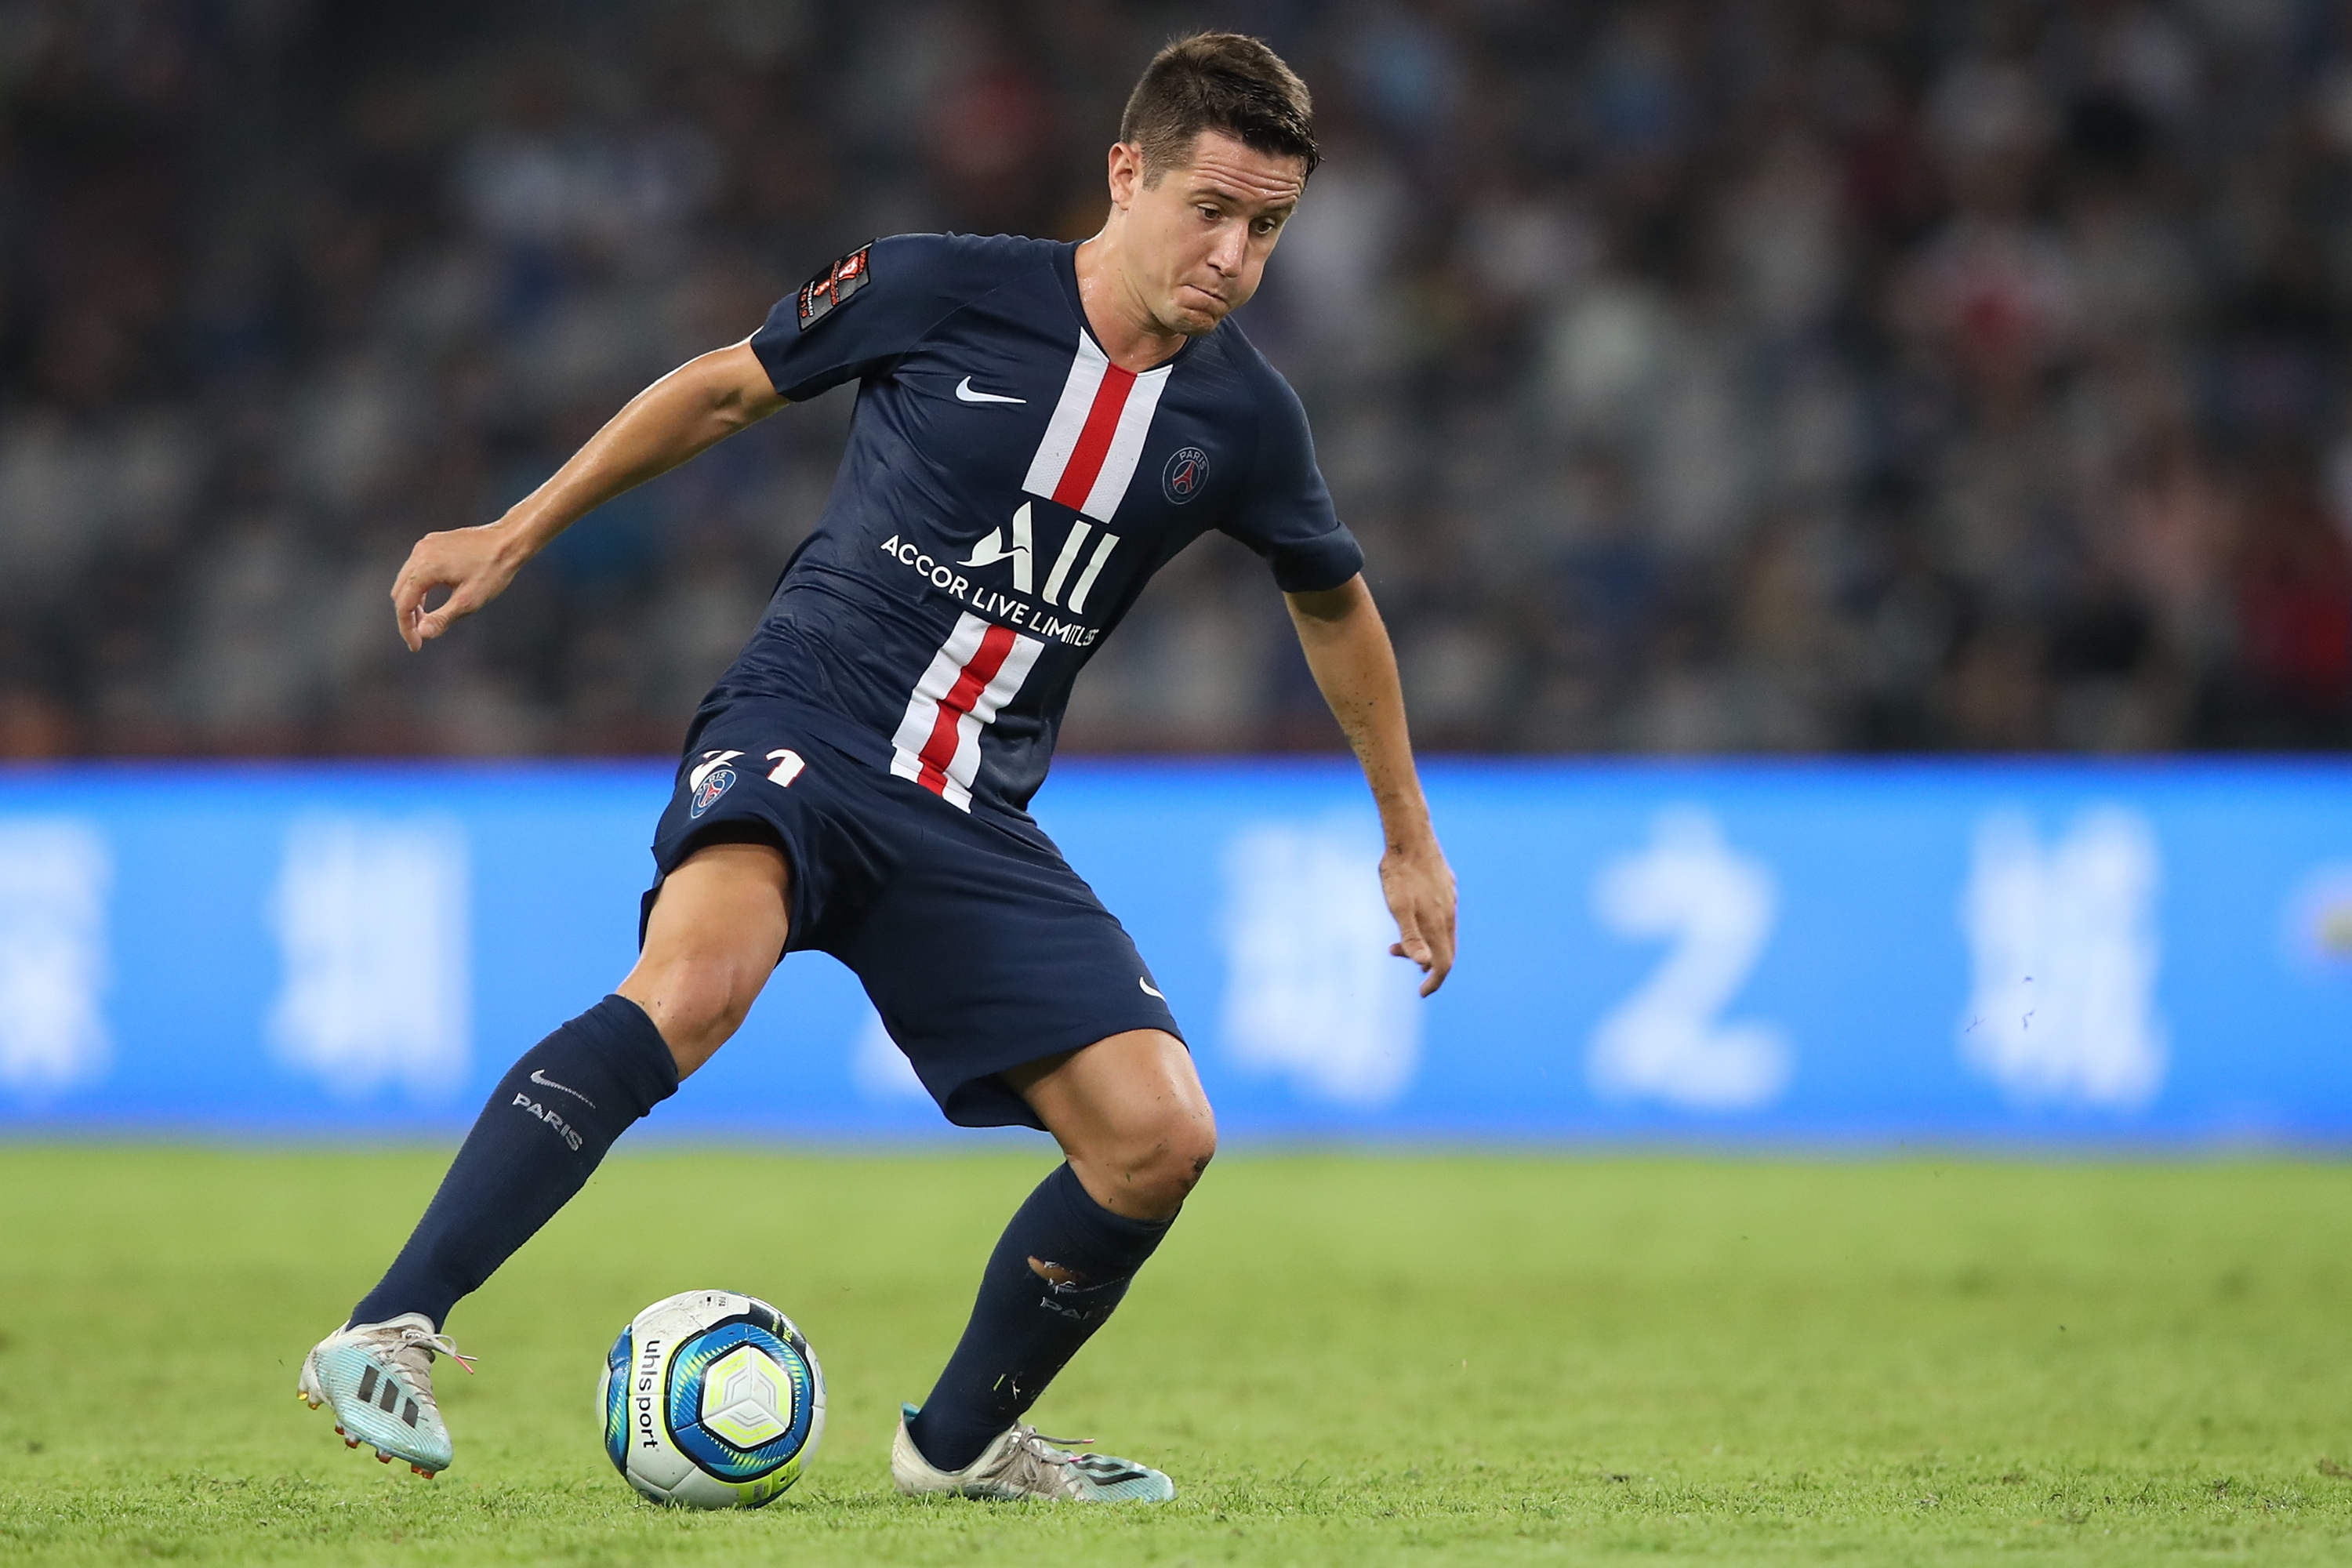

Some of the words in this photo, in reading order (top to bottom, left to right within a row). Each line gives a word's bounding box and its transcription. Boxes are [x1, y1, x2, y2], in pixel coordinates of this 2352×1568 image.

[1179, 449, 1207, 470] PARIS
[880, 534, 970, 601] ACCOR
[971, 586, 1030, 625] LIVE
[511, 1092, 583, 1152] PARIS
[636, 1339, 661, 1449] uhlsport
